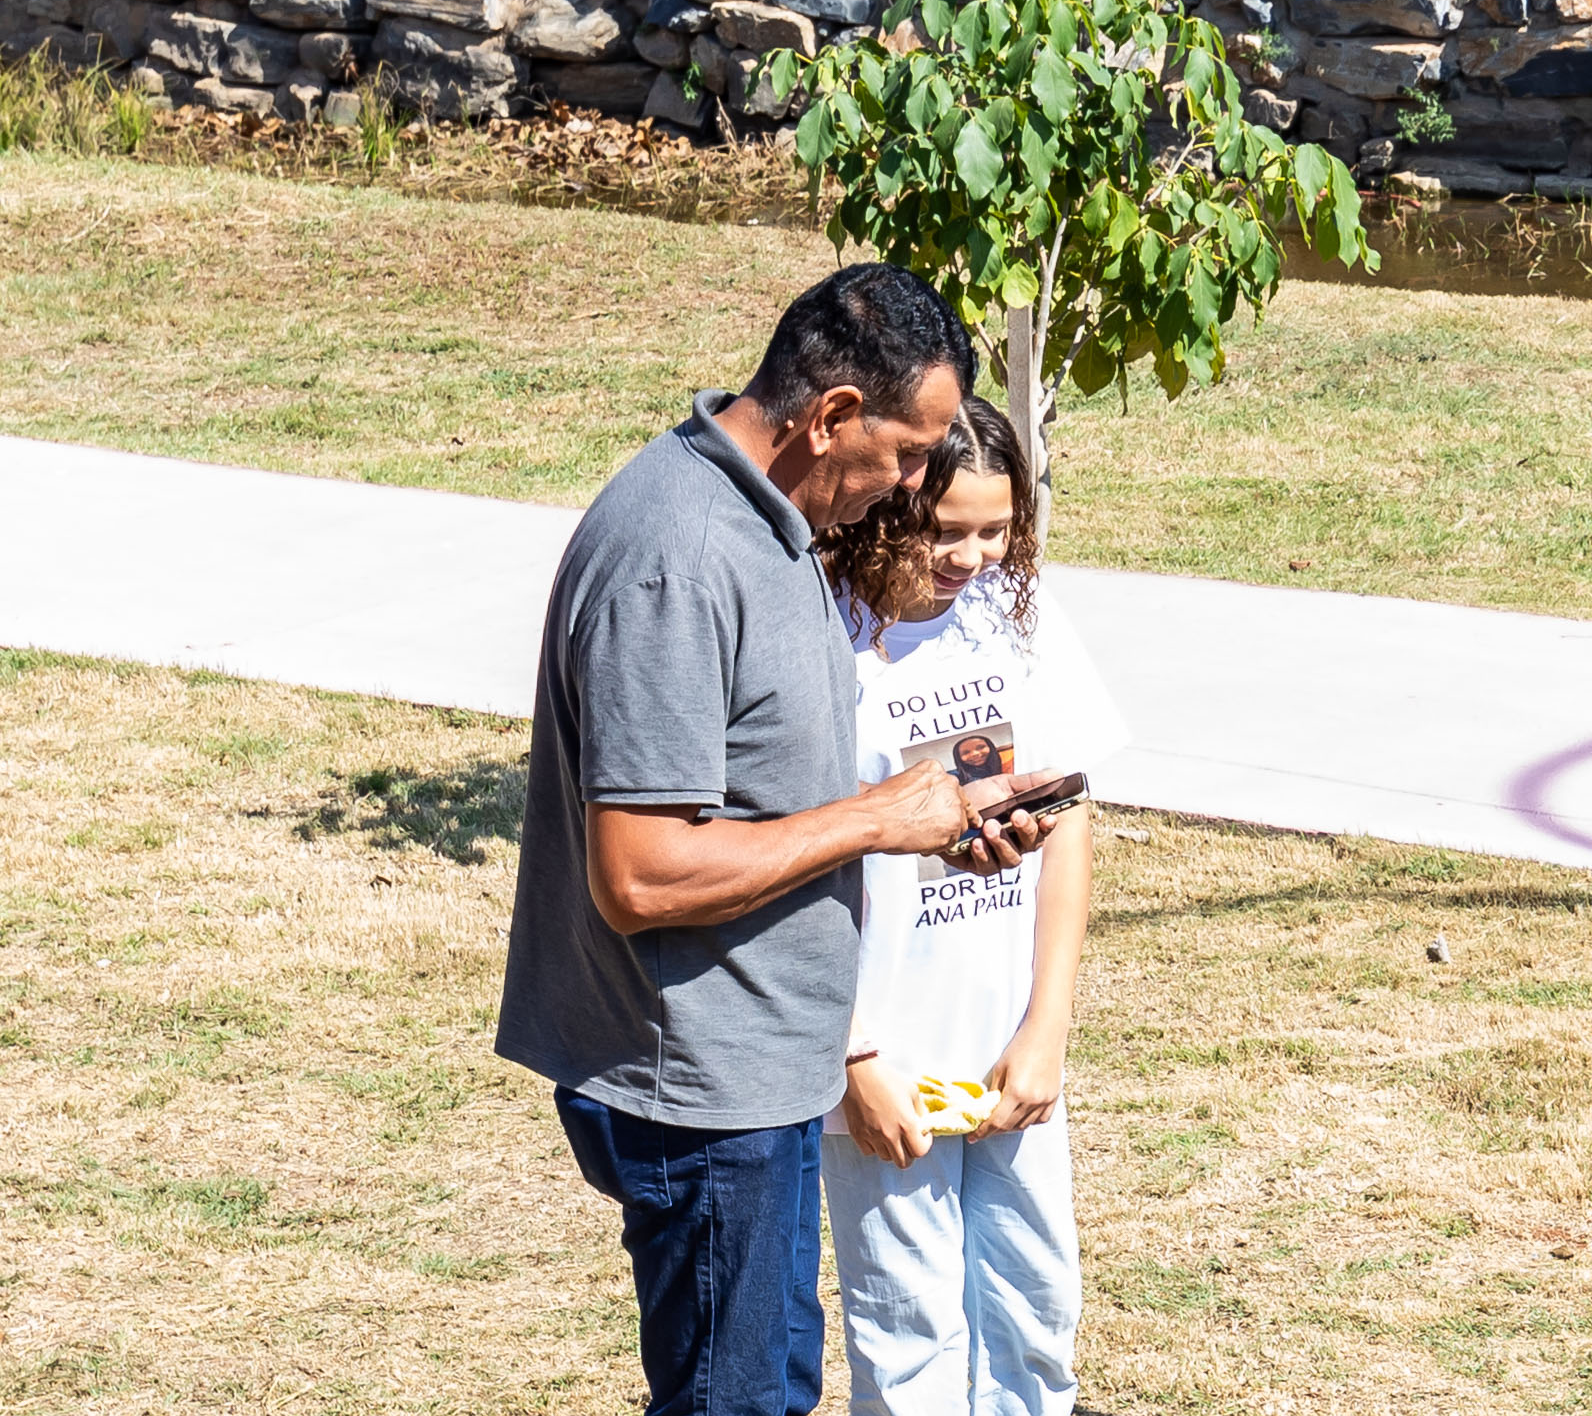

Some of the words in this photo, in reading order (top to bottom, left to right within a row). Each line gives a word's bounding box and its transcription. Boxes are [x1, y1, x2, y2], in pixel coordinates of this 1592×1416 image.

[887, 695, 927, 719] DO
[934, 675, 1006, 708] LUTO
[933, 703, 1003, 736] LUTA
[921, 879, 976, 905] POR
[915, 903, 965, 929] ANA
